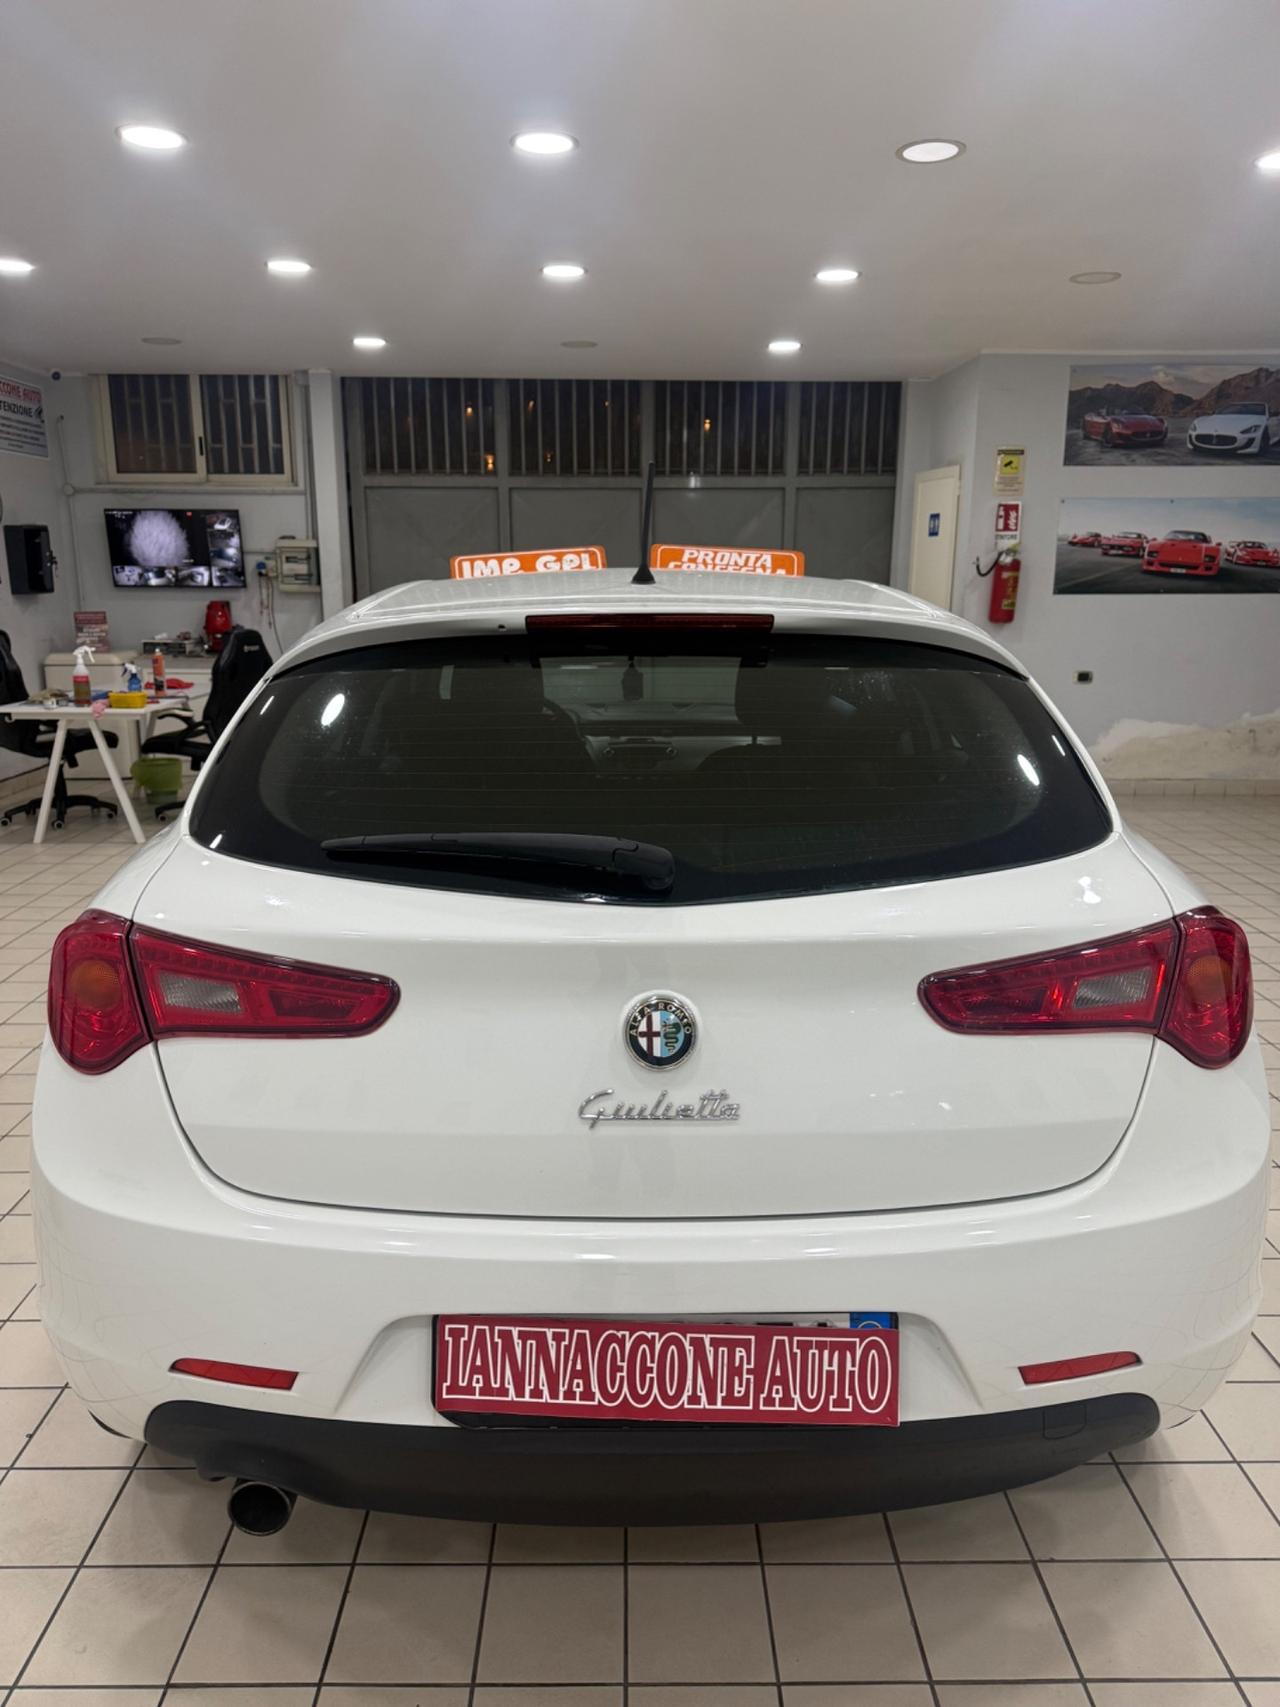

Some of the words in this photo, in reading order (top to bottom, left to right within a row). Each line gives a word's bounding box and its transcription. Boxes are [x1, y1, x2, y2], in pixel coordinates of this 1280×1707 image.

[681, 549, 773, 567] PRONTA
[629, 1006, 651, 1037] ALFA
[658, 1002, 692, 1034] ROMEO
[577, 1088, 741, 1131] Giulietta
[442, 1323, 756, 1409] IANNACCONE
[760, 1335, 893, 1413] AUTO
